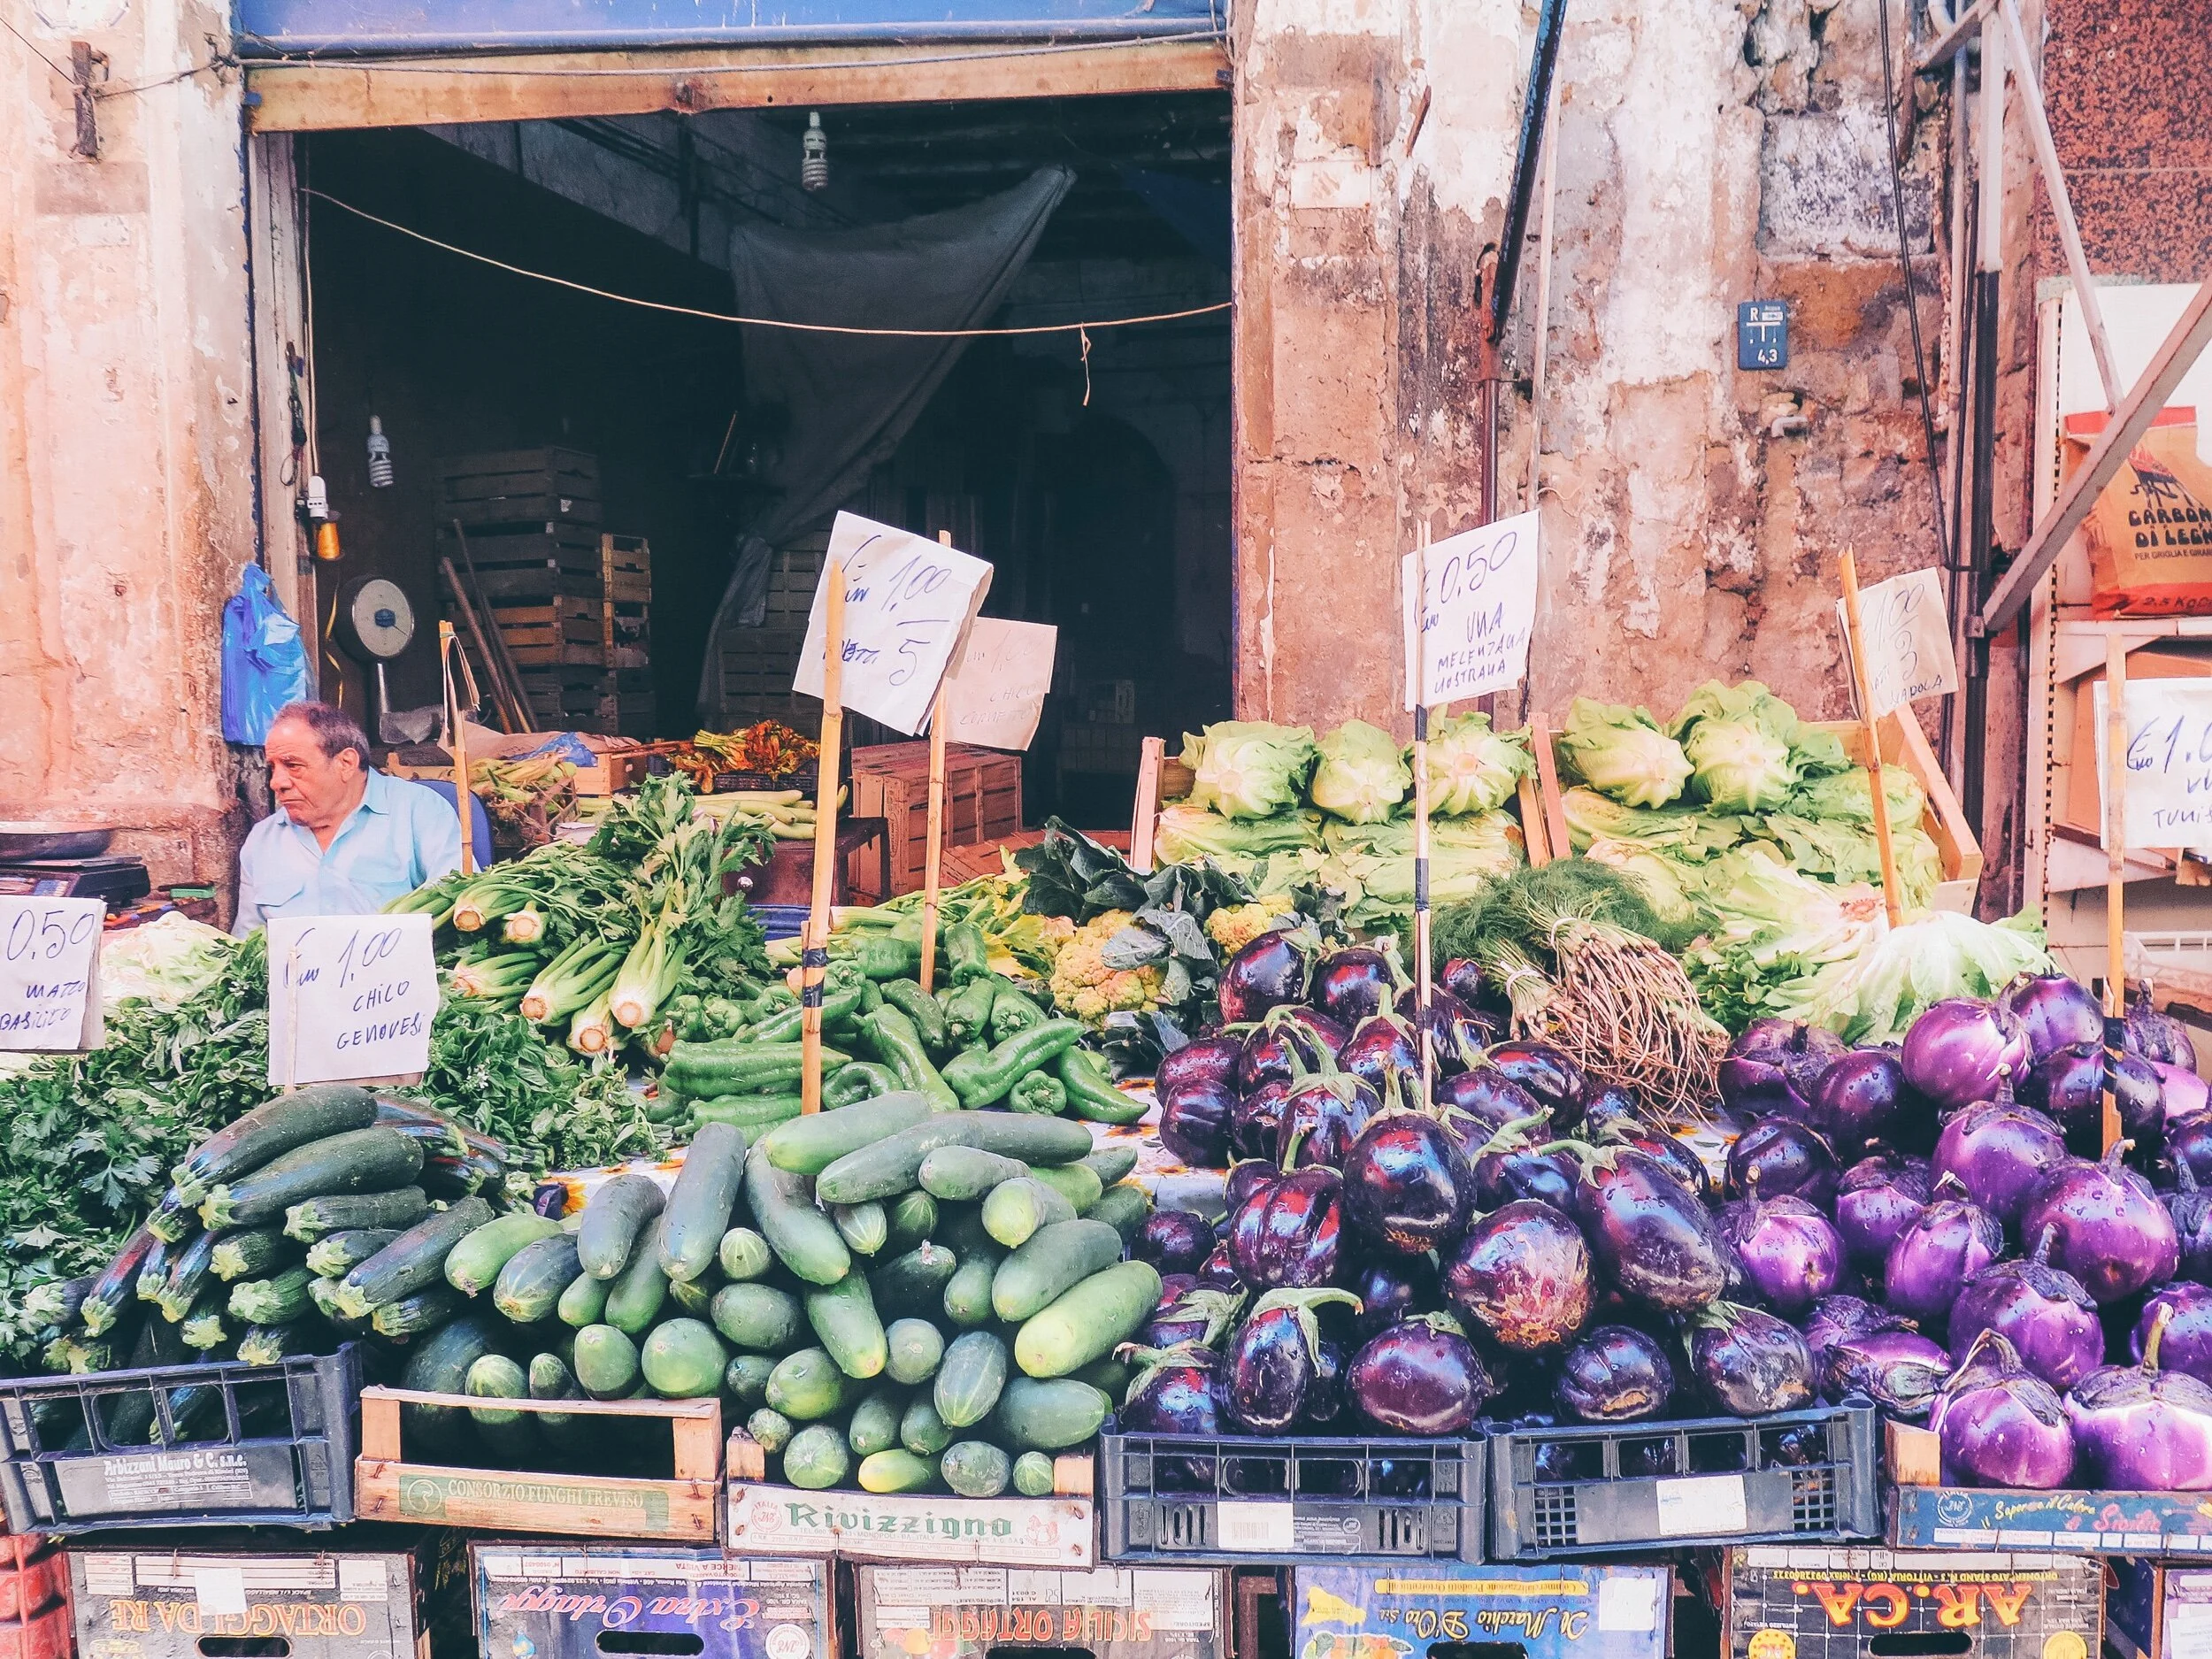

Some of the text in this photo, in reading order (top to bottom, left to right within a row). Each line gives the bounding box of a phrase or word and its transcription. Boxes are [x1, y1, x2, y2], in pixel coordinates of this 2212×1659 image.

[1757, 349, 1778, 365] 4,3
[1440, 531, 1517, 604] 0,50
[888, 638, 931, 687] 5
[7, 909, 95, 961] 0,50
[337, 927, 403, 988] 1,00
[104, 1455, 157, 1476] Arbizzani
[157, 1455, 191, 1472] Mauro
[193, 1453, 204, 1469] &
[448, 1479, 644, 1509] CONSORZIO FUNGHI TREVISO
[784, 1502, 1011, 1540] Rivizzigno
[108, 1599, 152, 1633] RE
[153, 1601, 204, 1635] DA
[495, 1585, 760, 1632] Extra Ortaggi
[932, 1605, 1153, 1643] SICILIA ORTAGGI
[1403, 1609, 1471, 1640] D'Oro
[1475, 1607, 1560, 1640] Marchio
[1559, 1610, 1590, 1641] Il
